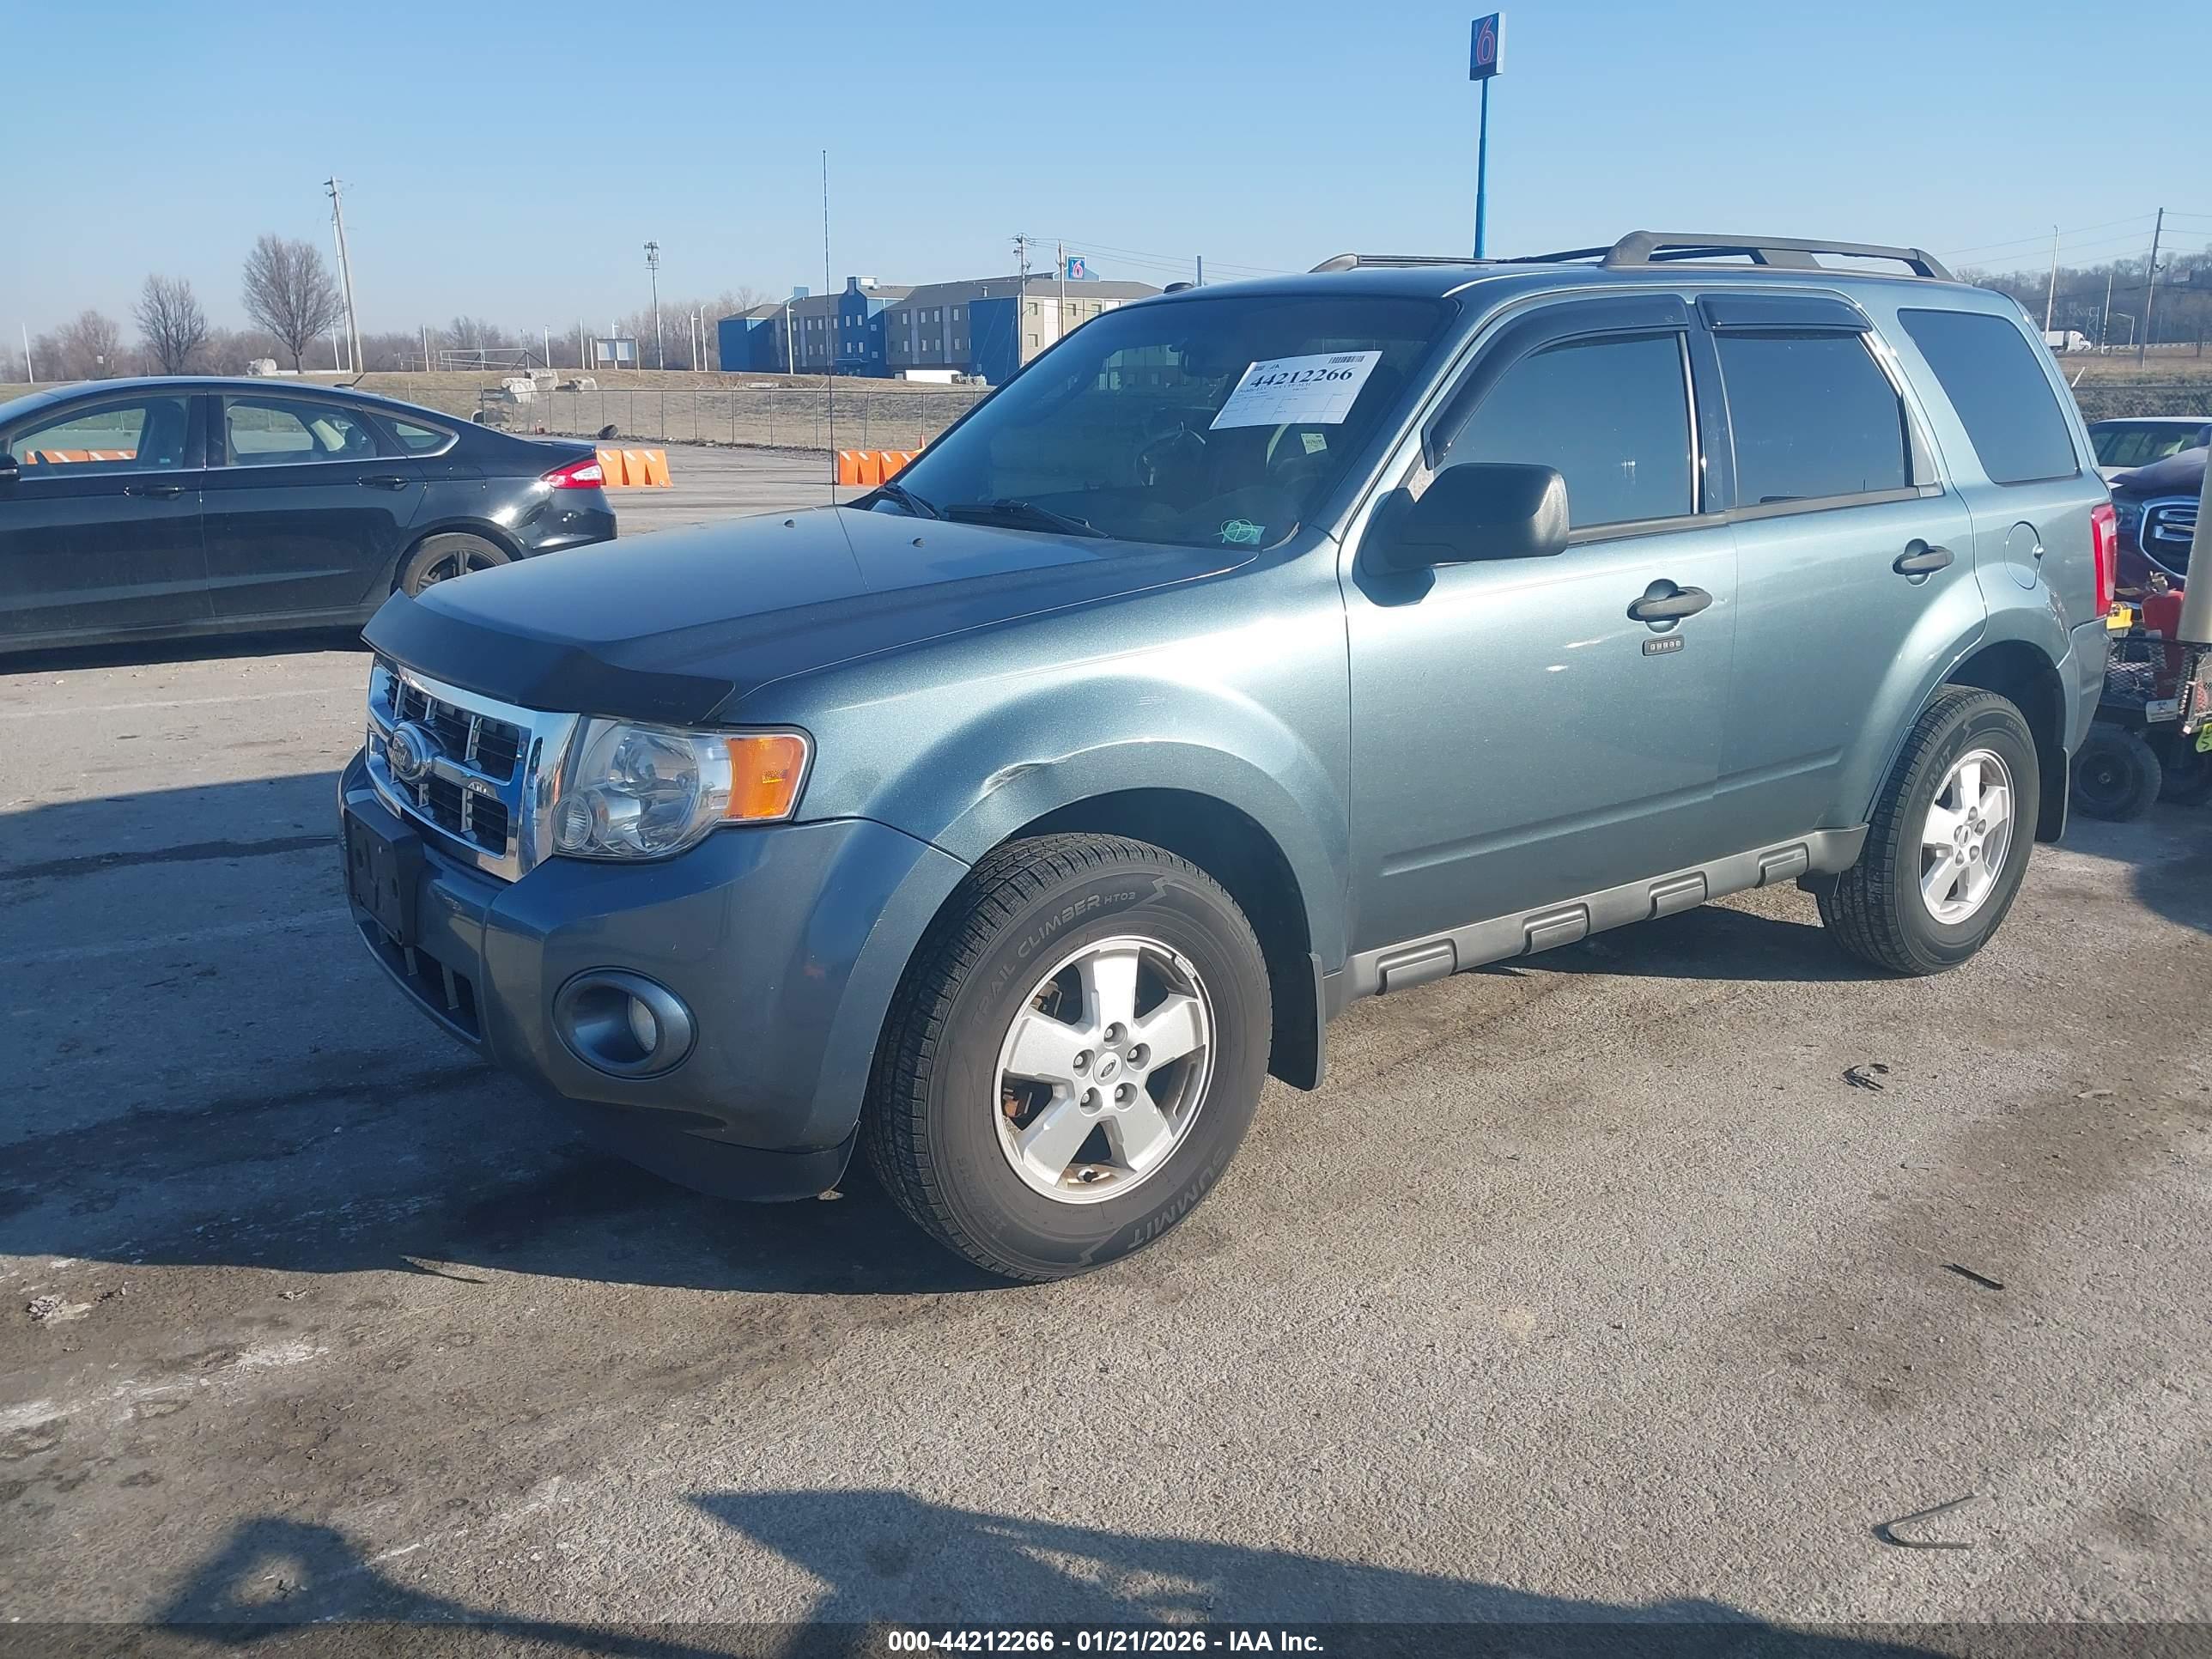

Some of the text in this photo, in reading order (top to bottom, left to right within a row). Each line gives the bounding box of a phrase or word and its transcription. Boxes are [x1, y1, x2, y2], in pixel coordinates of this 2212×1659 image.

[1476, 16, 1496, 65] 6
[1073, 260, 1084, 279] 6
[1250, 367, 1357, 387] 44212266
[1018, 894, 1101, 957] CLIMBER
